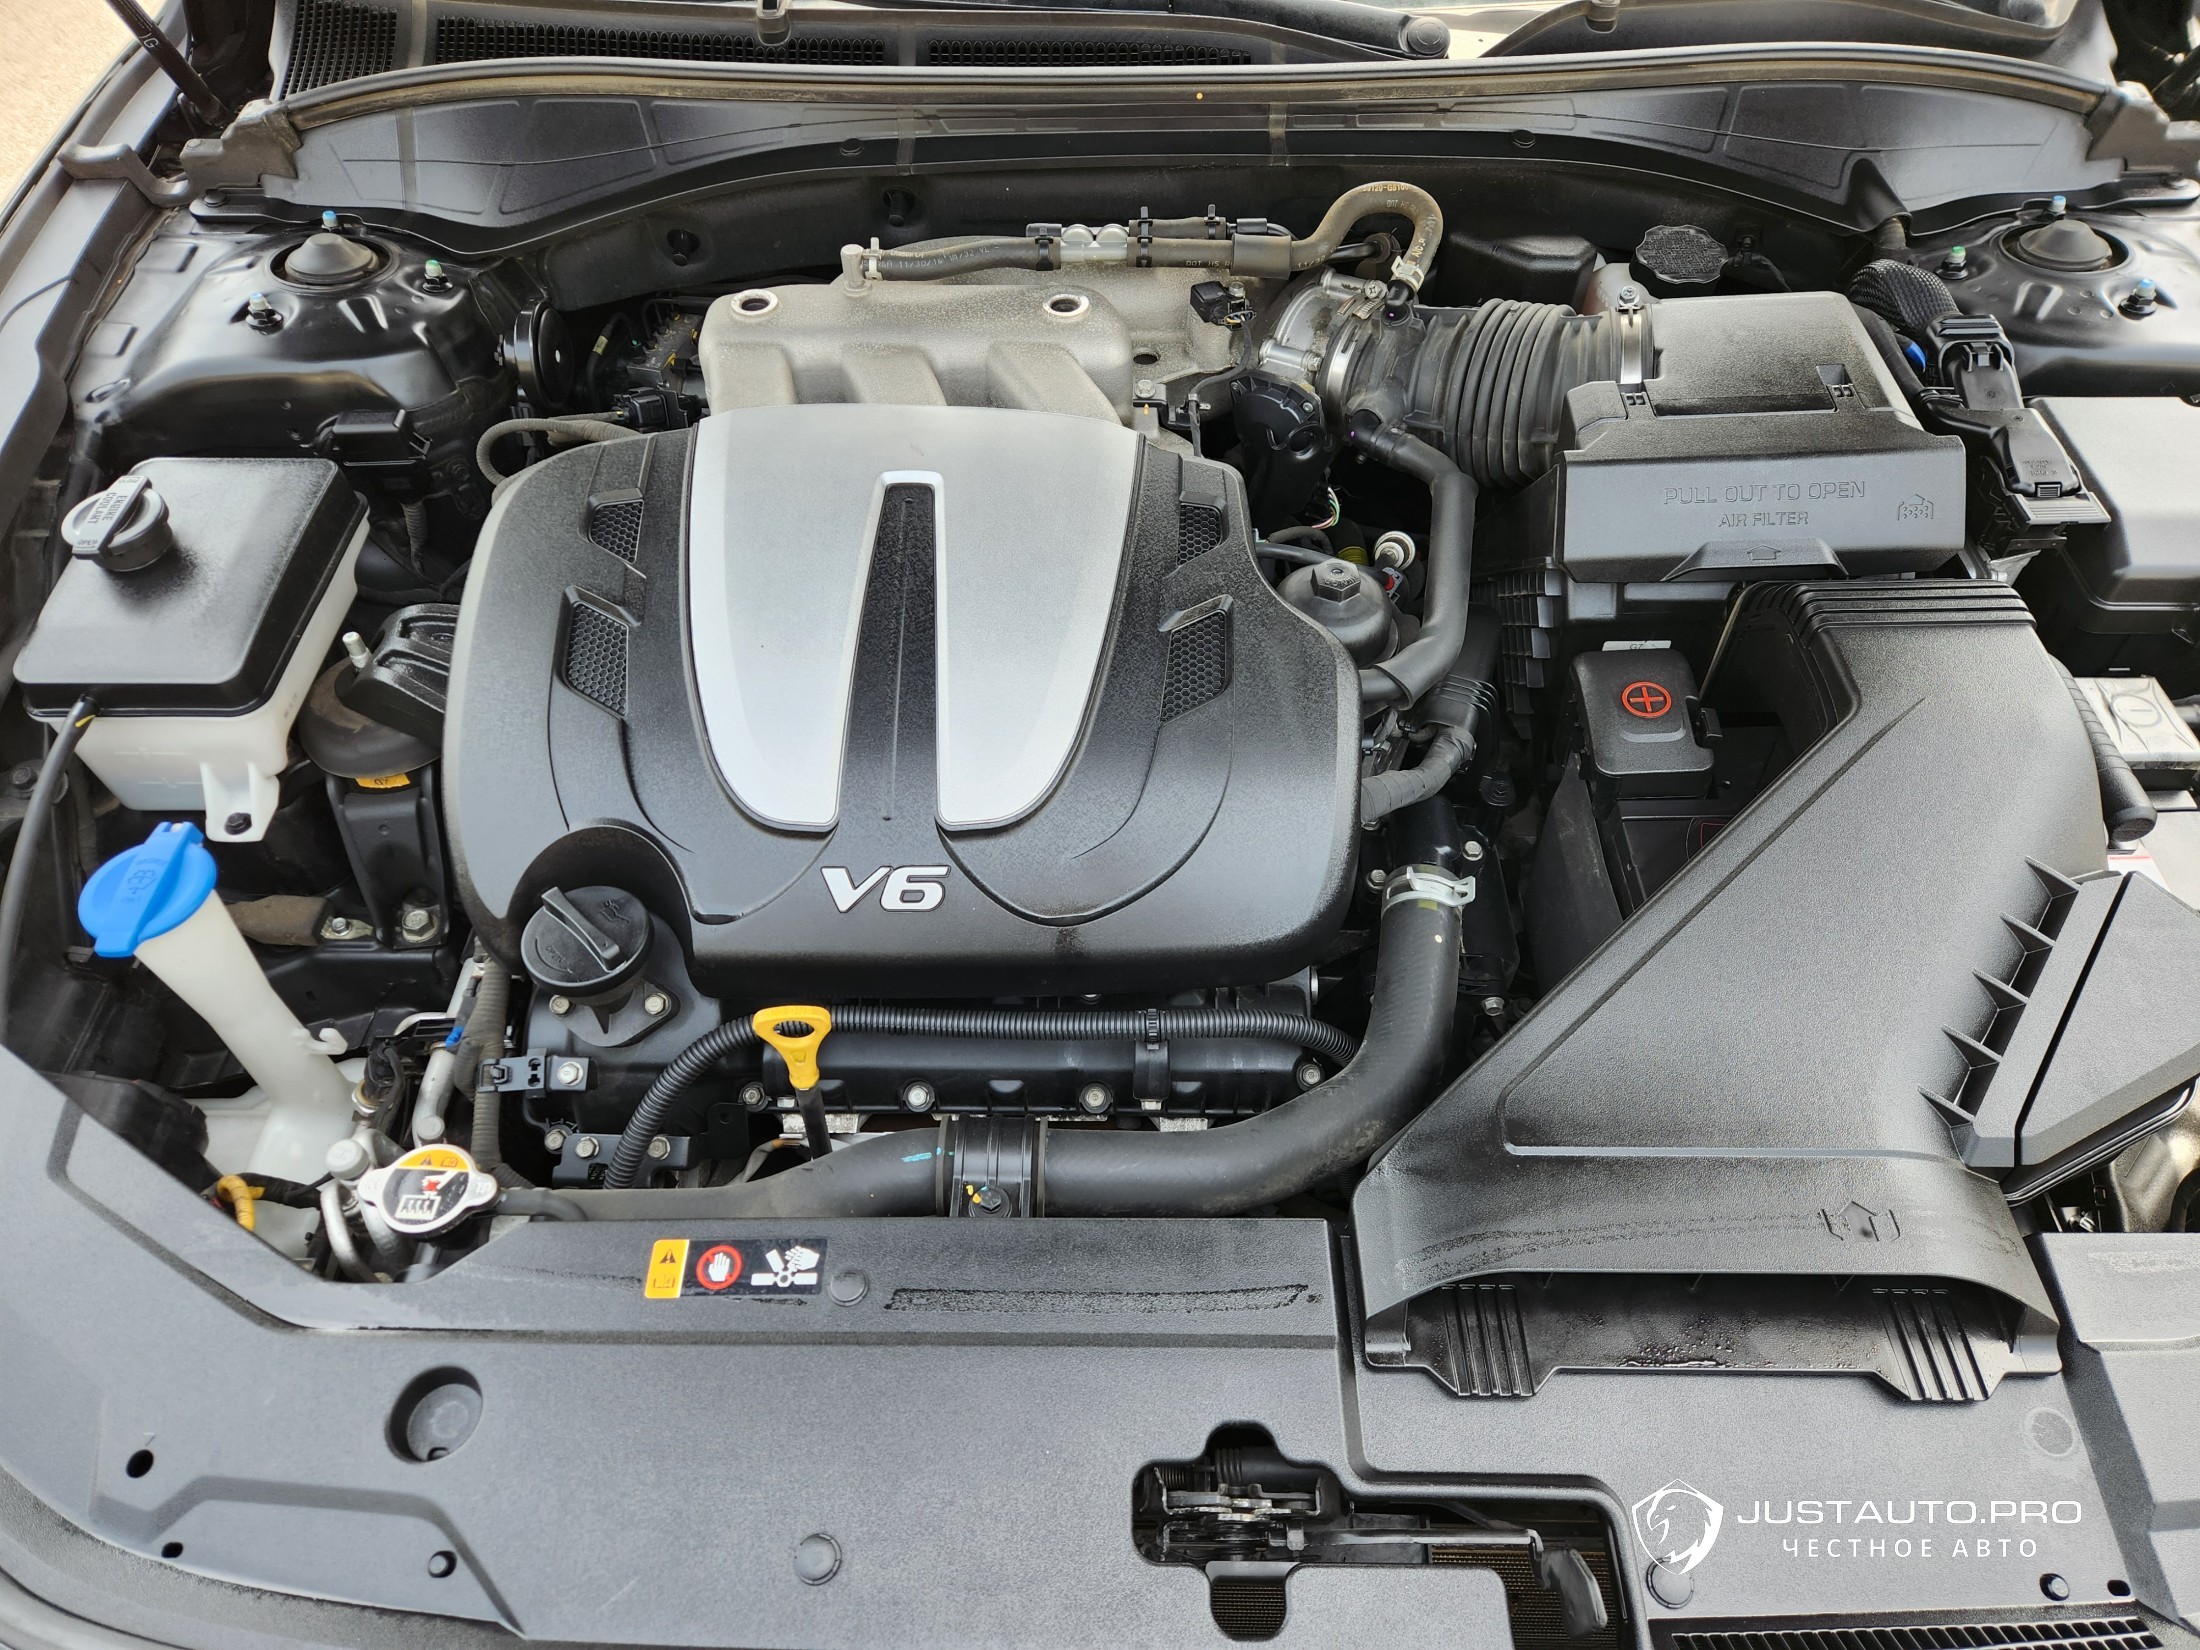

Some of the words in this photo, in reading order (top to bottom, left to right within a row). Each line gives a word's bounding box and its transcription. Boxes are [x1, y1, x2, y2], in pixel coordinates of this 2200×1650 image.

[1663, 486, 1718, 505] PULL
[1724, 484, 1767, 503] OUT
[1772, 482, 1801, 501] TO
[1807, 480, 1866, 500] OPEN
[1718, 513, 1747, 528] AIR
[1752, 510, 1809, 527] FILTER
[820, 864, 952, 914] V6
